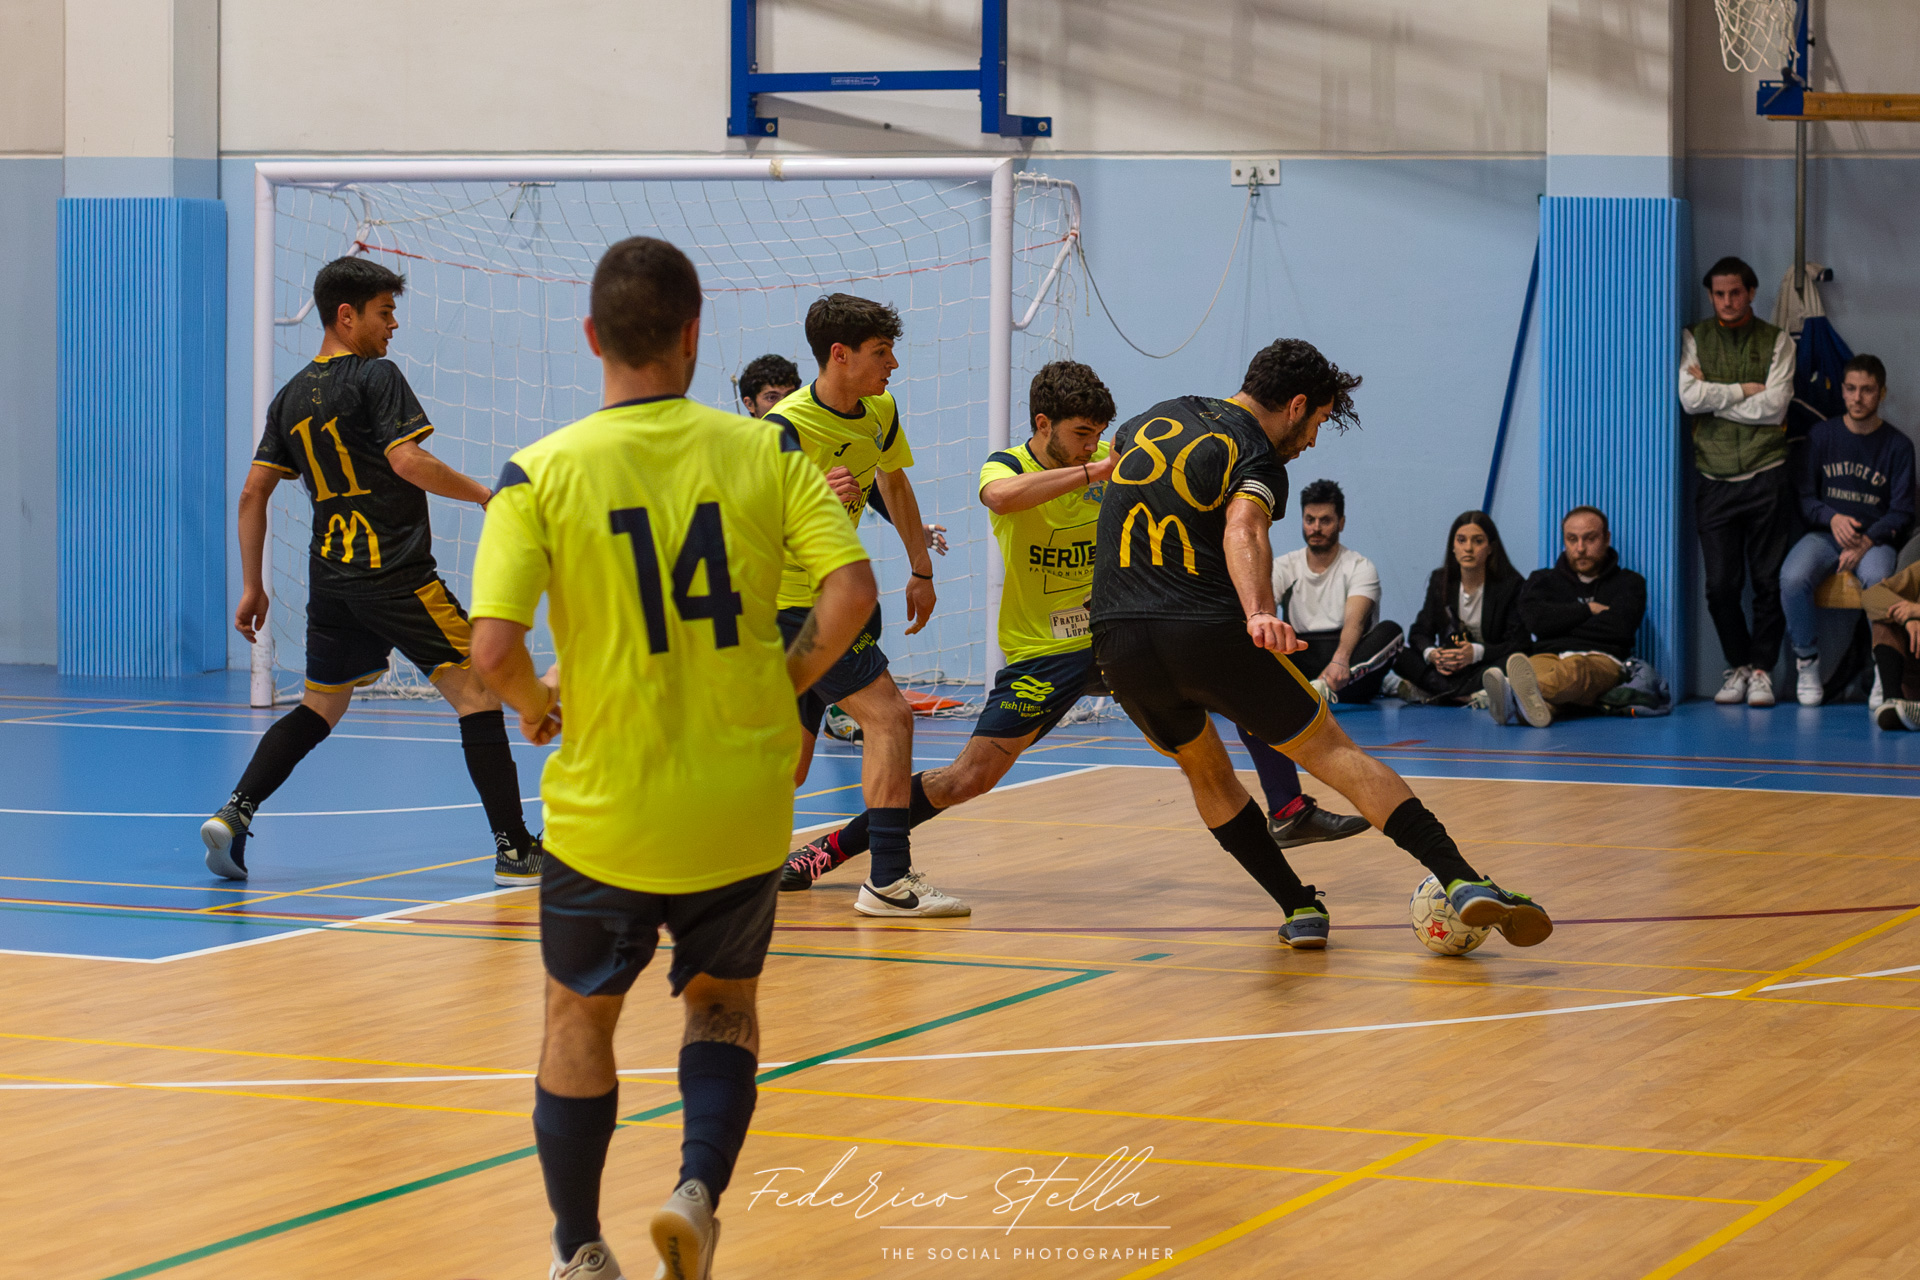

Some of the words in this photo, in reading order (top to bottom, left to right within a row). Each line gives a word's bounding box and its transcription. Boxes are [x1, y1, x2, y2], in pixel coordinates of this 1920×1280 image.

[289, 416, 372, 502] 11
[1111, 416, 1239, 512] 80
[609, 501, 743, 656] 14
[1000, 701, 1017, 710] Fish
